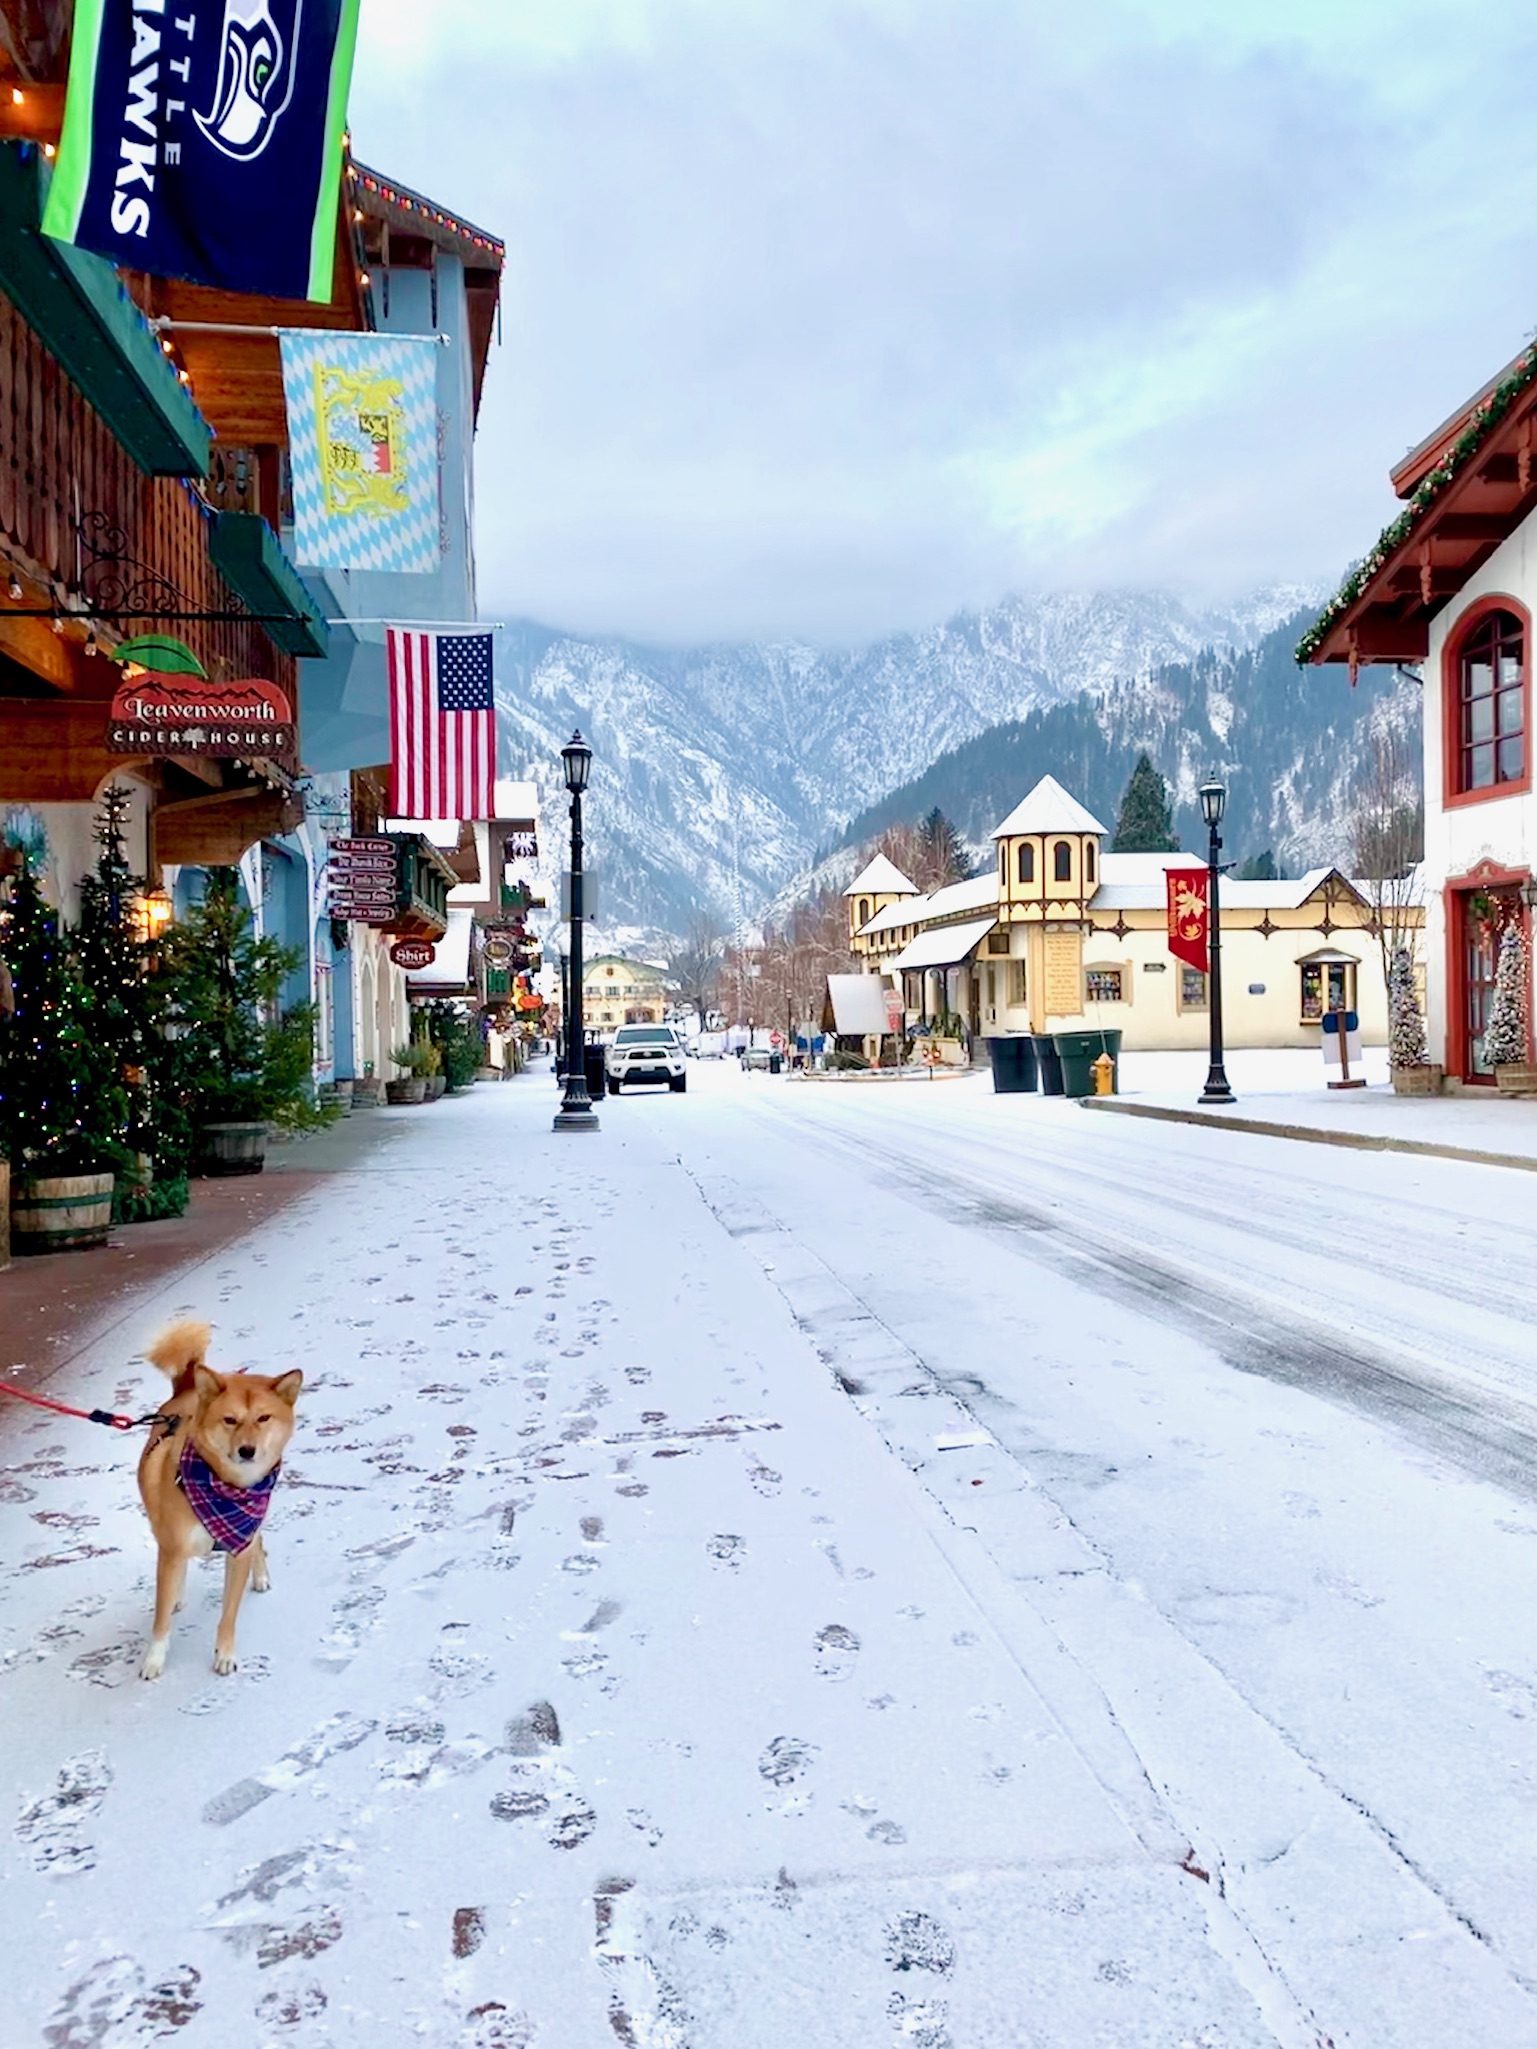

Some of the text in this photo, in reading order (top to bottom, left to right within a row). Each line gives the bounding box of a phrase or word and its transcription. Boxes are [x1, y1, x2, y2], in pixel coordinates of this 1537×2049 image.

[111, 0, 165, 238] AWKS
[124, 697, 275, 725] Leavenworth
[113, 730, 284, 746] CIDER HOUSE
[395, 948, 430, 962] Shirt
